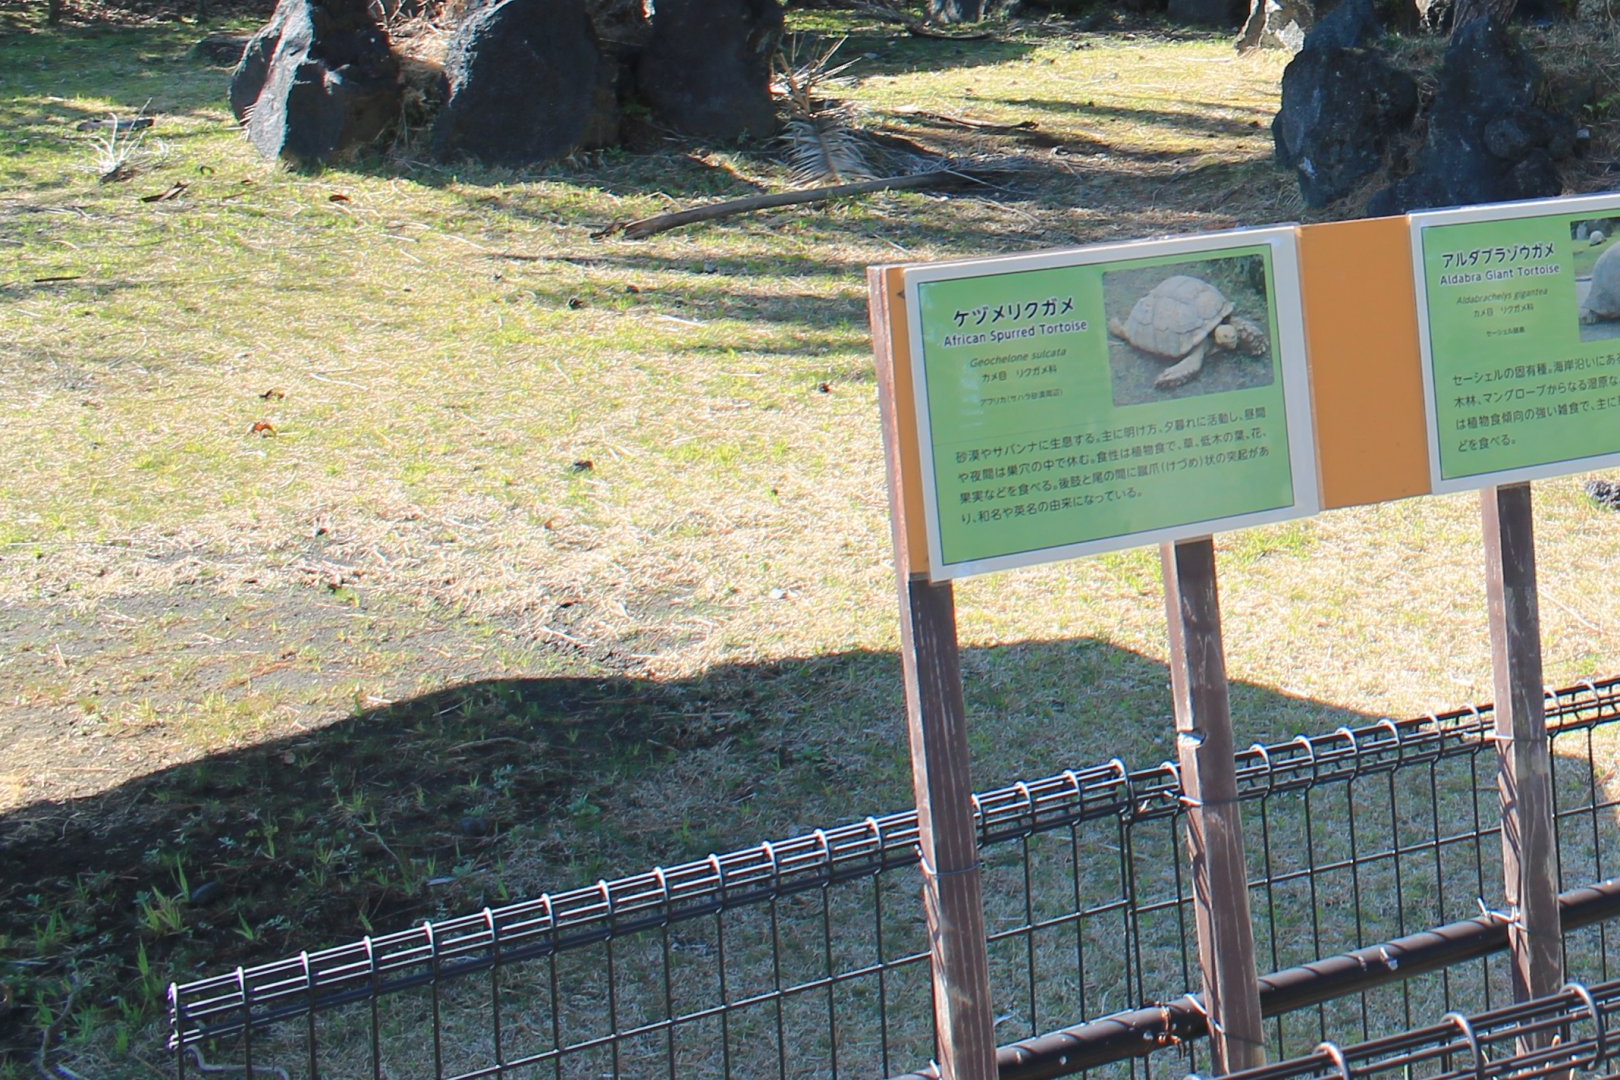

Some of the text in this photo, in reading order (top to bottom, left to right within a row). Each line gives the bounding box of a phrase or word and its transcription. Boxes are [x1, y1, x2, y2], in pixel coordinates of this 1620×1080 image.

[1442, 243, 1554, 268] アルダブラゾウガメ
[1440, 264, 1560, 286] Aldabra Giant Tortoise
[954, 297, 1074, 327] ケヅメリクガメ
[944, 320, 1088, 347] African Spurred Tortoise
[970, 347, 1067, 368] Geochelone sulcata
[982, 365, 1057, 383] カメ目 リクガメ科
[1458, 434, 1516, 452] どを食べる。
